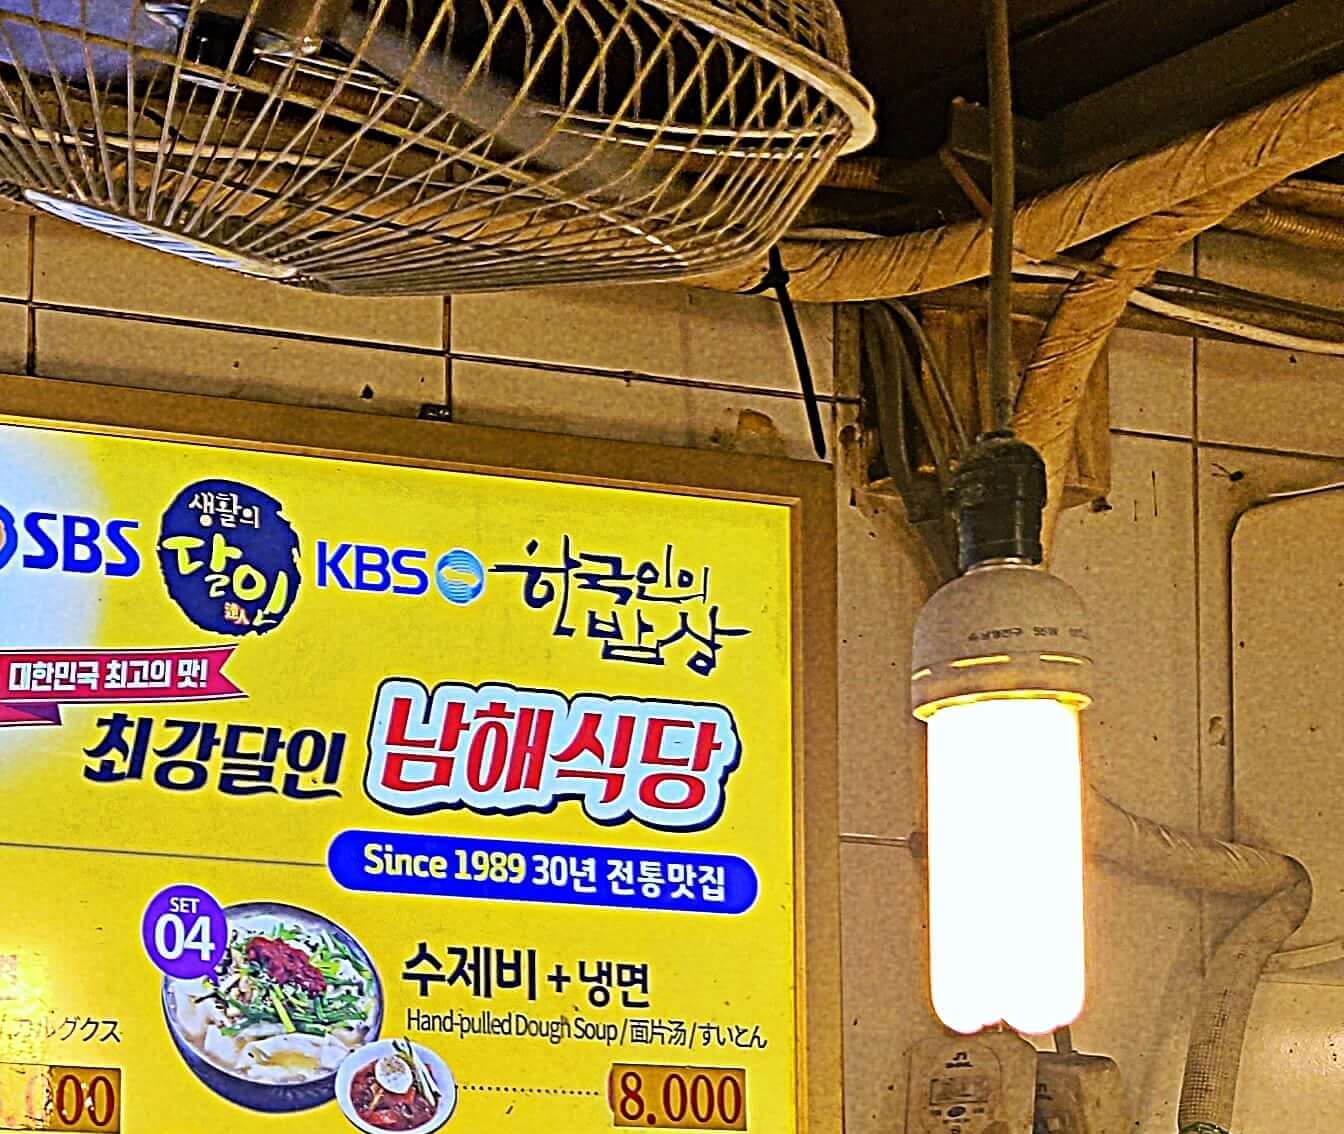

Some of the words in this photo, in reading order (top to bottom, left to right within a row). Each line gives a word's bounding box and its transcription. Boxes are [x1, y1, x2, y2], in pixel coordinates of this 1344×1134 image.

[188, 491, 260, 529] 생활의
[23, 511, 141, 578] SBS
[315, 539, 430, 596] KBS
[162, 532, 289, 626] 달인
[488, 534, 710, 638] 한국인의
[587, 605, 753, 677] 밥상
[8, 660, 100, 692] 대한민국
[104, 659, 172, 690] 최고의
[176, 658, 208, 689] 맛!
[82, 711, 347, 800] 최강달인
[379, 696, 723, 811] 남해식당
[363, 842, 448, 880] Since
[454, 848, 527, 885] 1989
[531, 853, 598, 895] 30년
[606, 858, 726, 902] 전통맛집
[169, 896, 200, 915] SET
[153, 913, 217, 962] 04
[407, 1007, 512, 1039] Hand-pulled
[515, 1014, 572, 1045] Dough
[573, 1017, 619, 1046] Soup
[619, 1070, 743, 1126] 8.000
